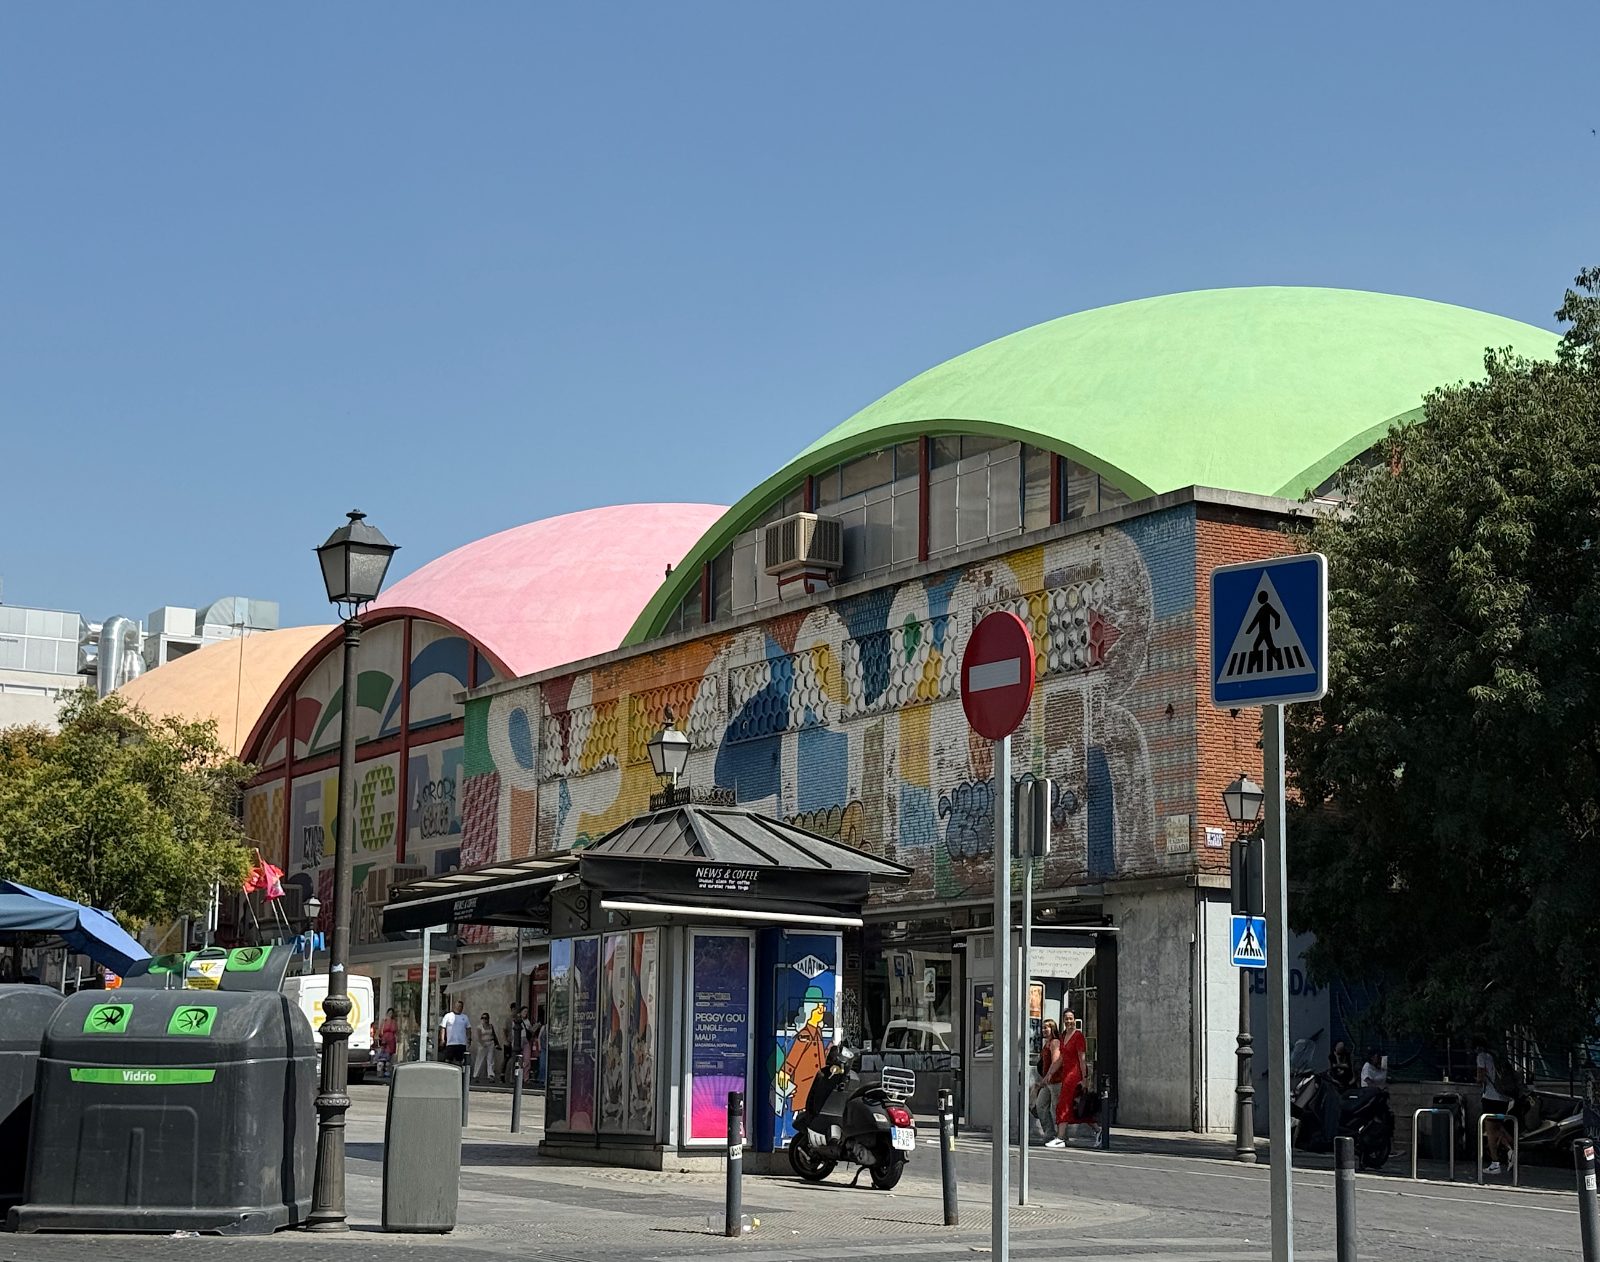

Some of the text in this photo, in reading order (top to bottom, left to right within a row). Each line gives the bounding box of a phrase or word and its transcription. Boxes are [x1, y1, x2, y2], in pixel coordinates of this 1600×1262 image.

[696, 867, 760, 880] NEWS & COFFEE
[1242, 969, 1317, 996] CEDA
[695, 1013, 745, 1022] PEGGY GOU
[695, 1024, 723, 1032] JUNGLE
[695, 1033, 711, 1041] MAU
[122, 1070, 157, 1081] Vidrio
[896, 1130, 913, 1139] 2139
